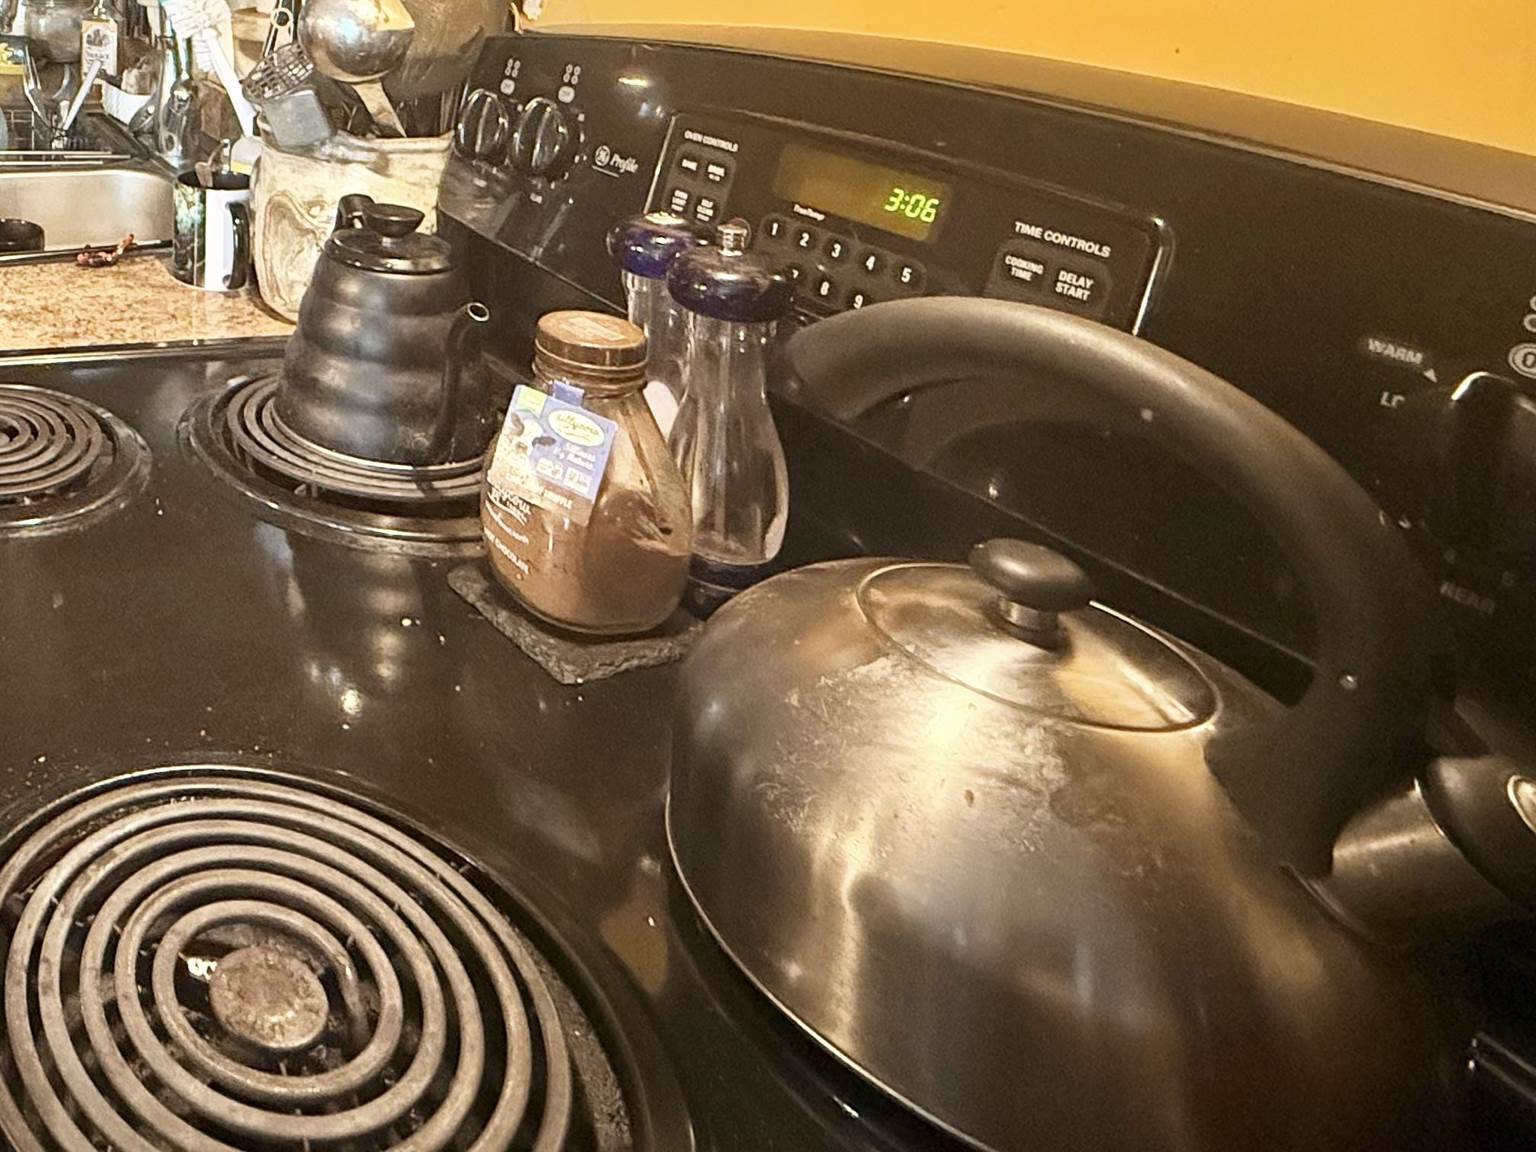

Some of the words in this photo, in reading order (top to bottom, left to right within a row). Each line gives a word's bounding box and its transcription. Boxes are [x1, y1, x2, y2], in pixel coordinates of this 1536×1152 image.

[610, 152, 638, 174] Profile
[884, 188, 940, 223] 3:06
[770, 222, 778, 236] 1
[799, 232, 810, 247] 2
[1015, 221, 1044, 239] TIME
[1044, 230, 1112, 258] CONTROLS
[831, 243, 842, 258] 3
[865, 255, 876, 270] 4
[1004, 255, 1044, 275] COOKING
[901, 266, 912, 283] 5
[1011, 267, 1032, 282] TIME
[1058, 270, 1094, 289] DELAY
[820, 281, 830, 296] 8
[1055, 281, 1091, 302] START
[853, 294, 864, 309] 9
[1368, 338, 1424, 366] WARM
